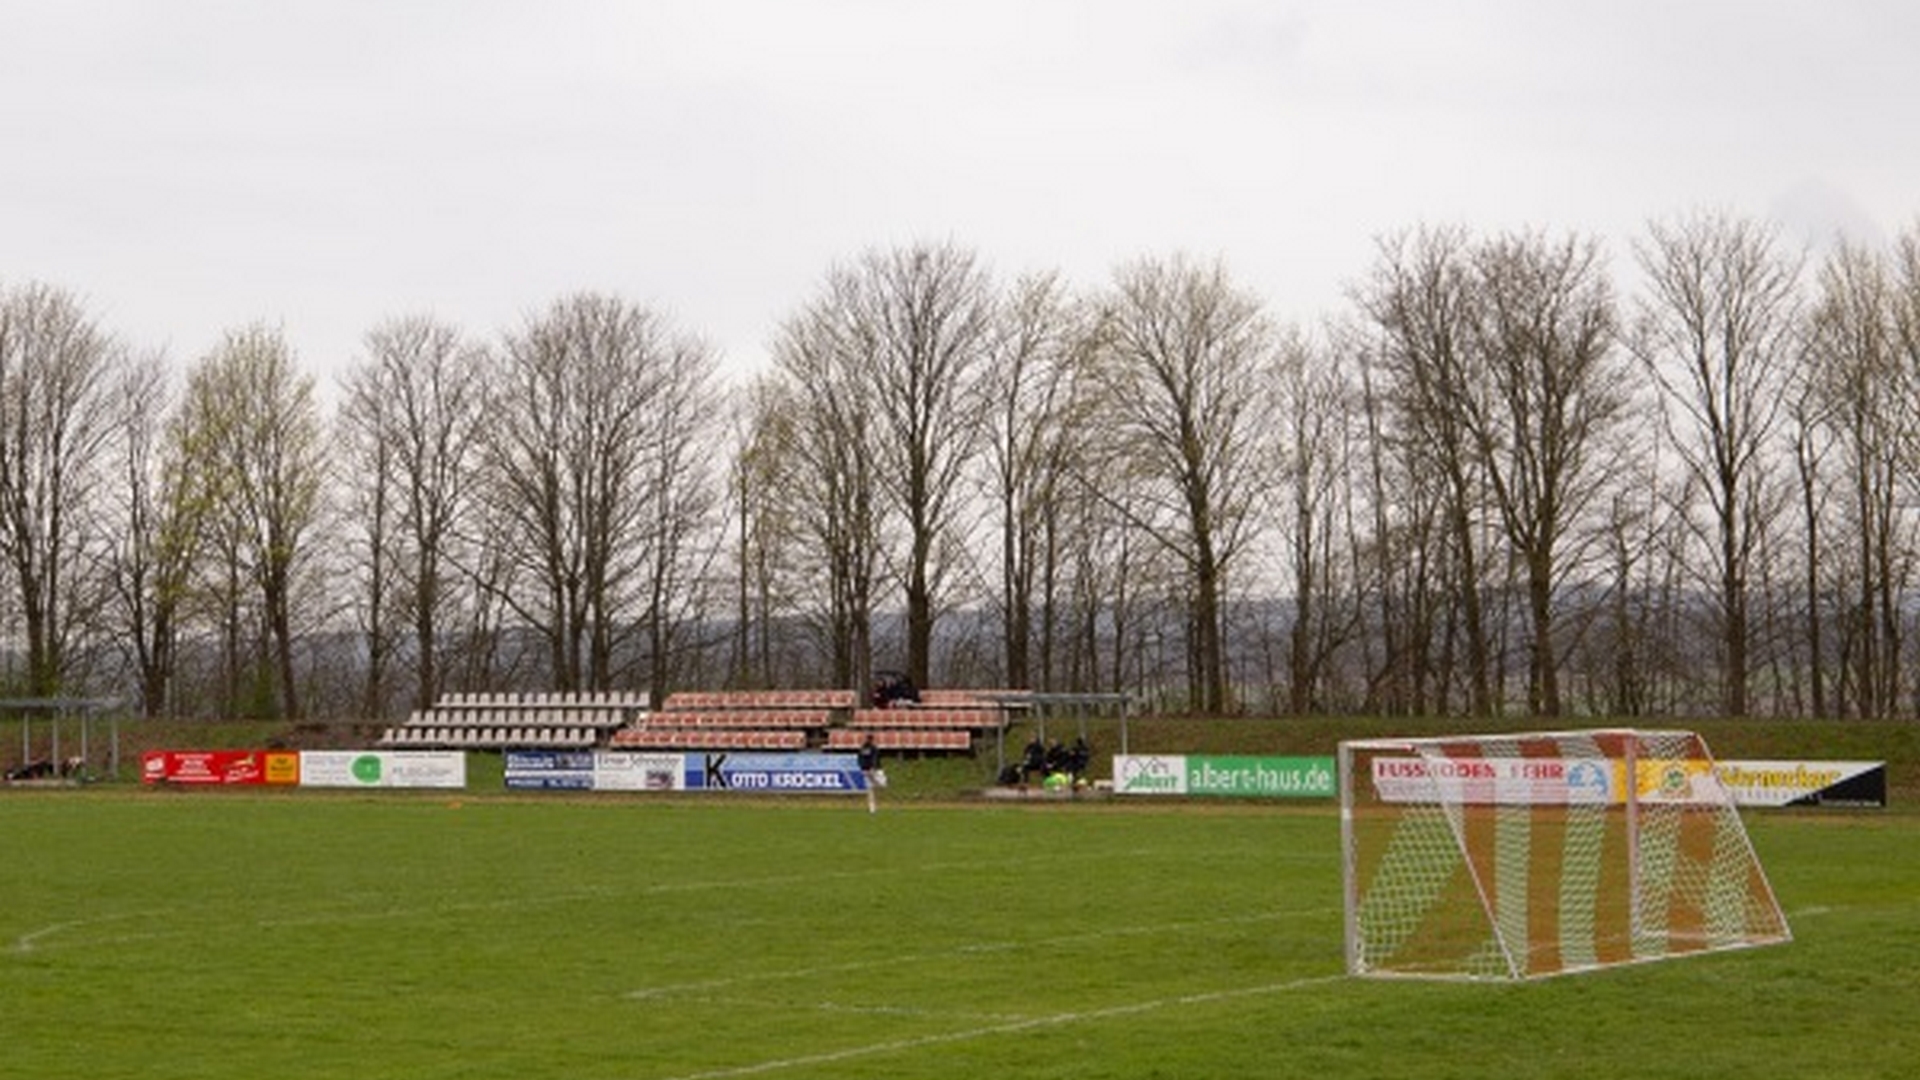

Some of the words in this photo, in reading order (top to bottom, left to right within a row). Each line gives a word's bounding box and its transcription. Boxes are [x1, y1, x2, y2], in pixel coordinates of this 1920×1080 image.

[706, 754, 728, 788] K
[731, 773, 769, 787] OTTO
[1190, 762, 1331, 790] albert-haus.de
